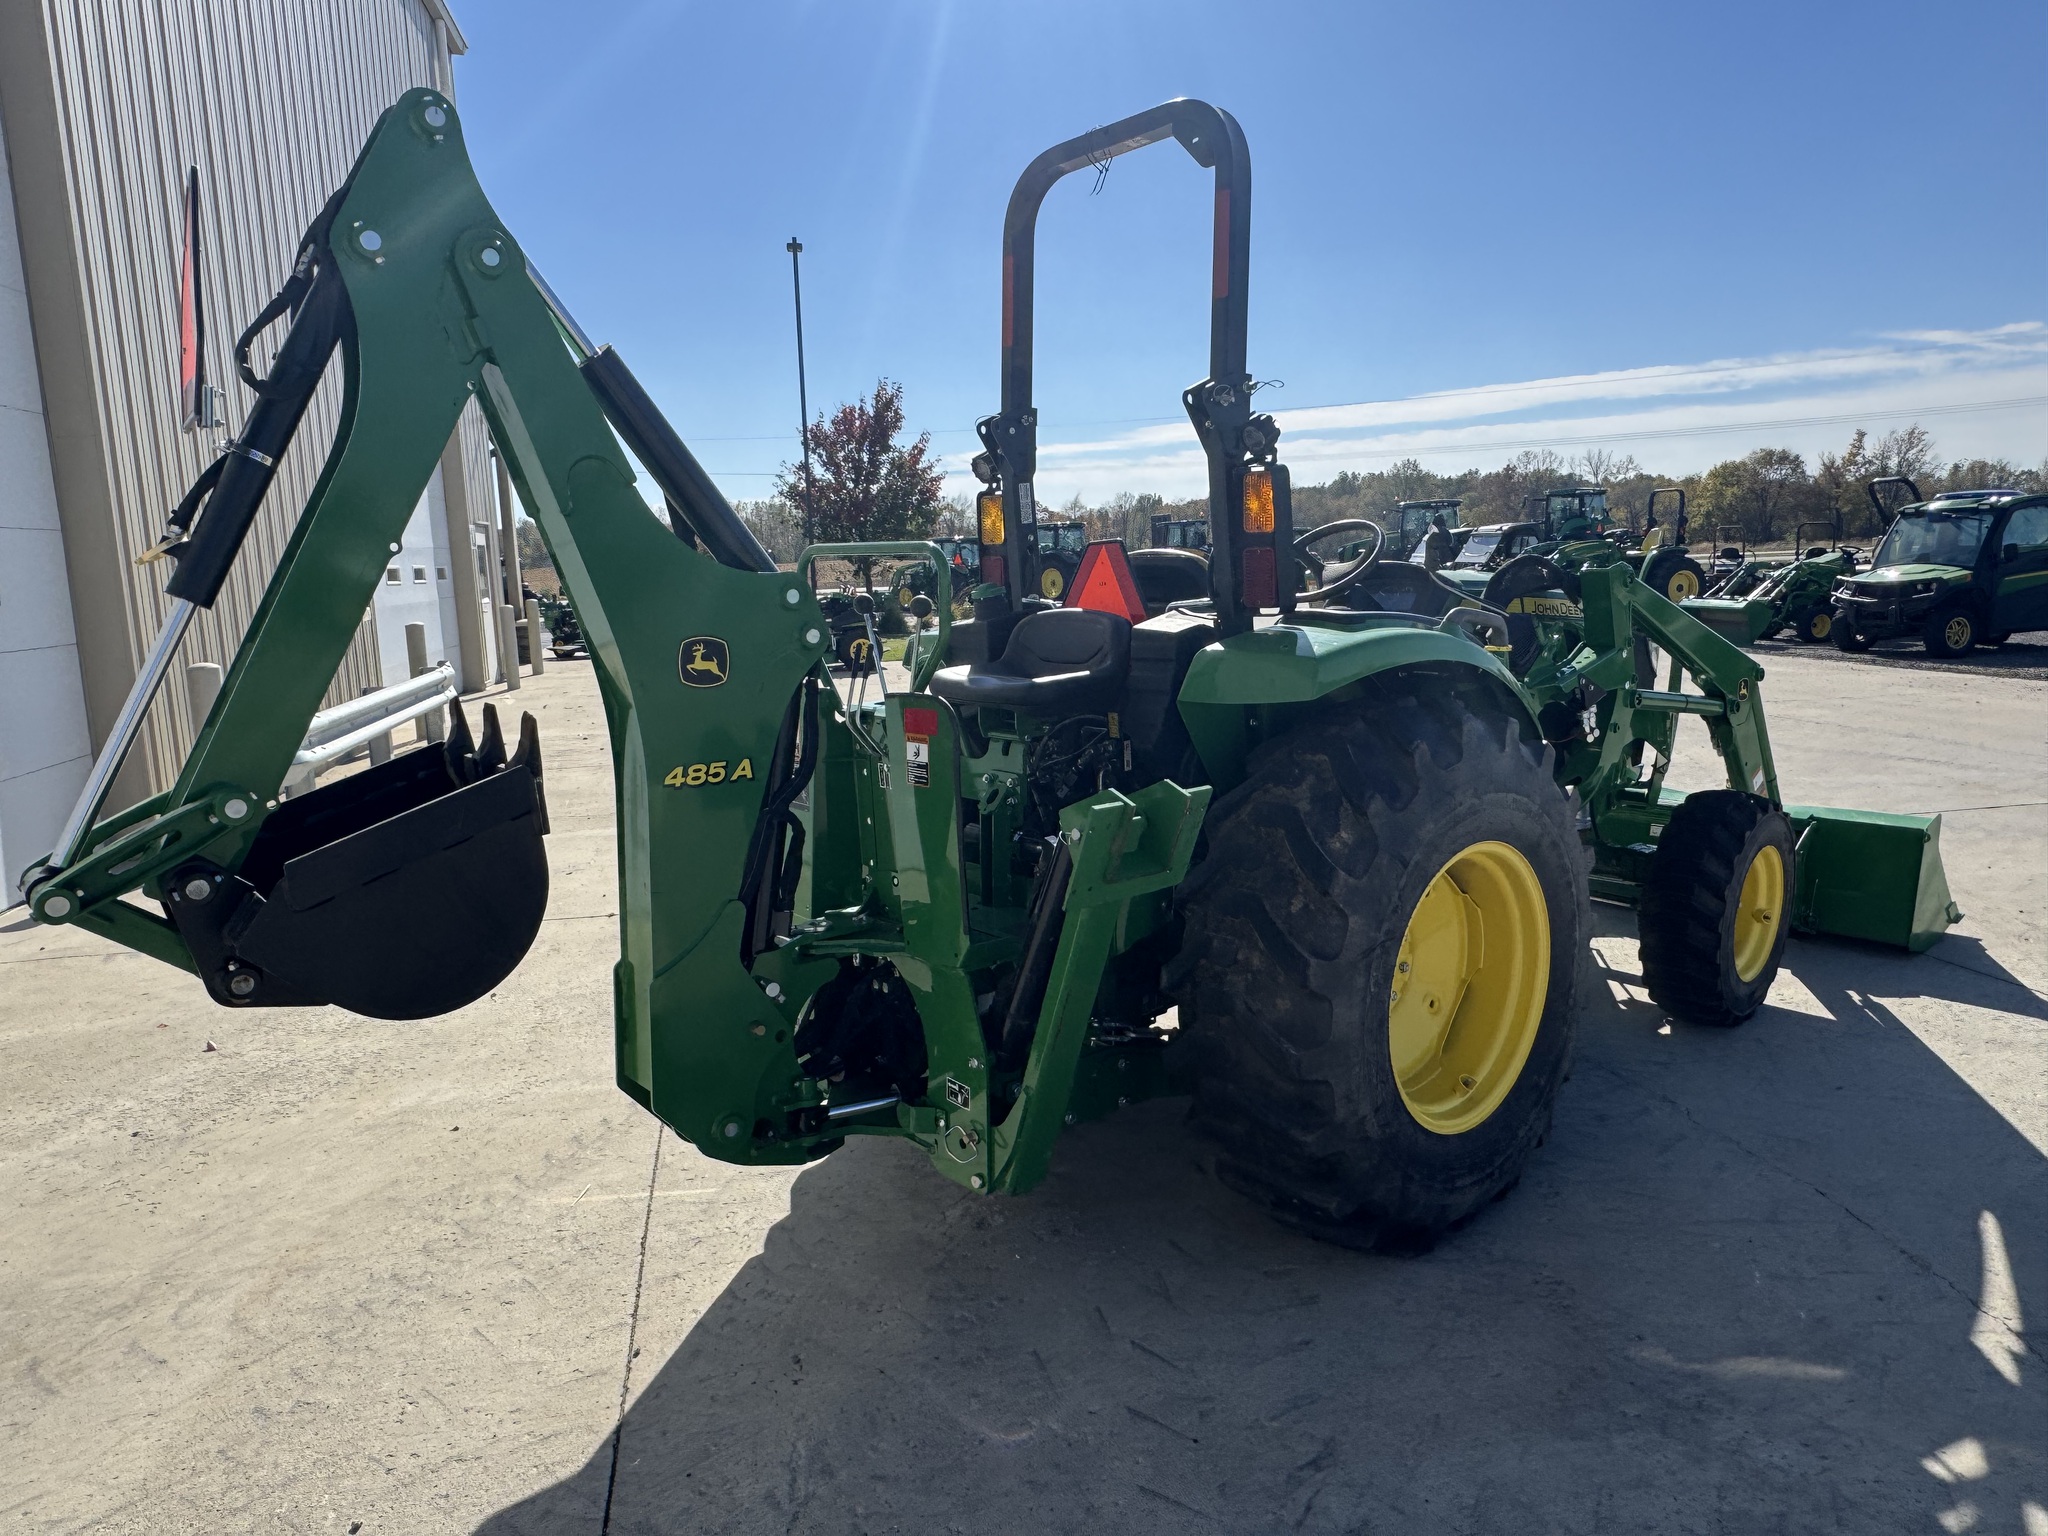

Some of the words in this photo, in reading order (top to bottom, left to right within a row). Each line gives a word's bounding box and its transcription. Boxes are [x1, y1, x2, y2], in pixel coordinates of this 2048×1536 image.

[1531, 600, 1559, 615] JOHN
[1560, 602, 1582, 617] DEE
[663, 761, 727, 788] 485
[730, 758, 754, 781] A
